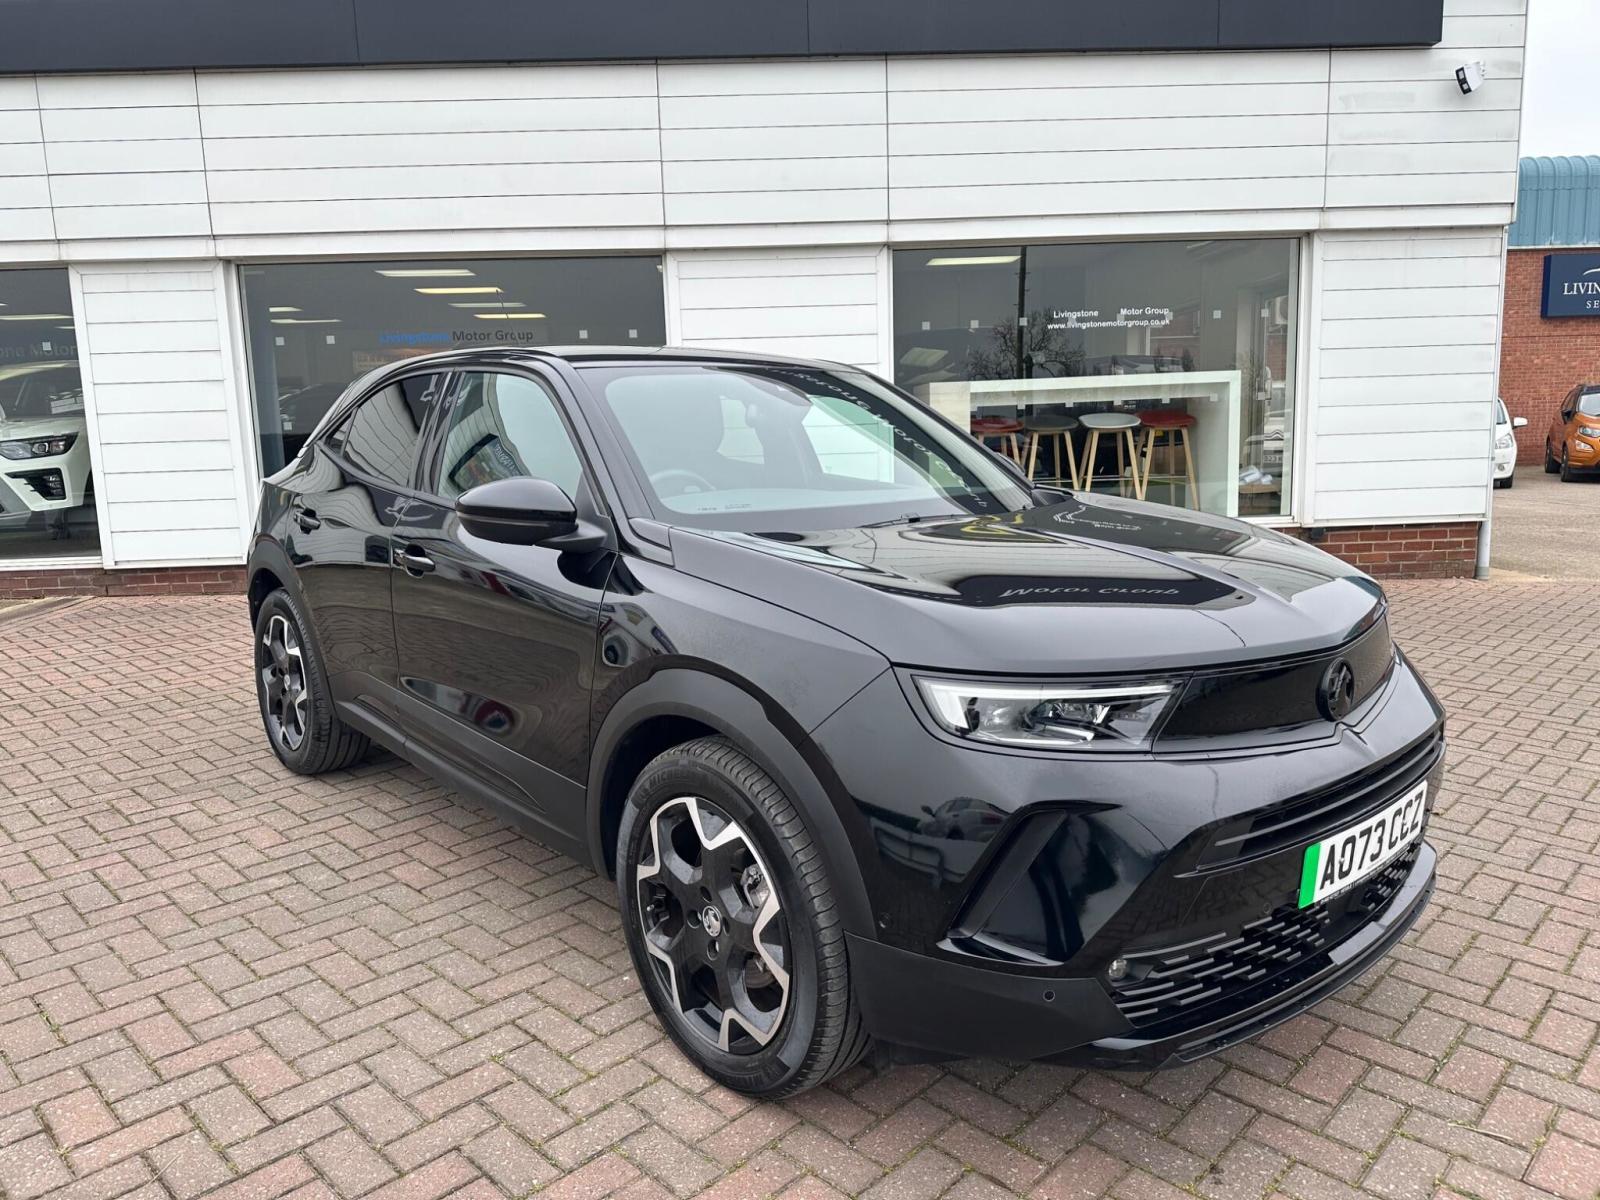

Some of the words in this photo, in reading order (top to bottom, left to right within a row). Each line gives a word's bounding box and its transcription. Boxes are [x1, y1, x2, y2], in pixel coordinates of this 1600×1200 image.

[1053, 309, 1099, 319] Livingstone
[1120, 307, 1143, 316] Motor
[1145, 306, 1170, 317] Group
[1047, 317, 1170, 330] www.livingstonemotorgroup.co.uk
[452, 331, 491, 342] Motor
[495, 329, 534, 343] Group
[1320, 818, 1386, 890] AO73
